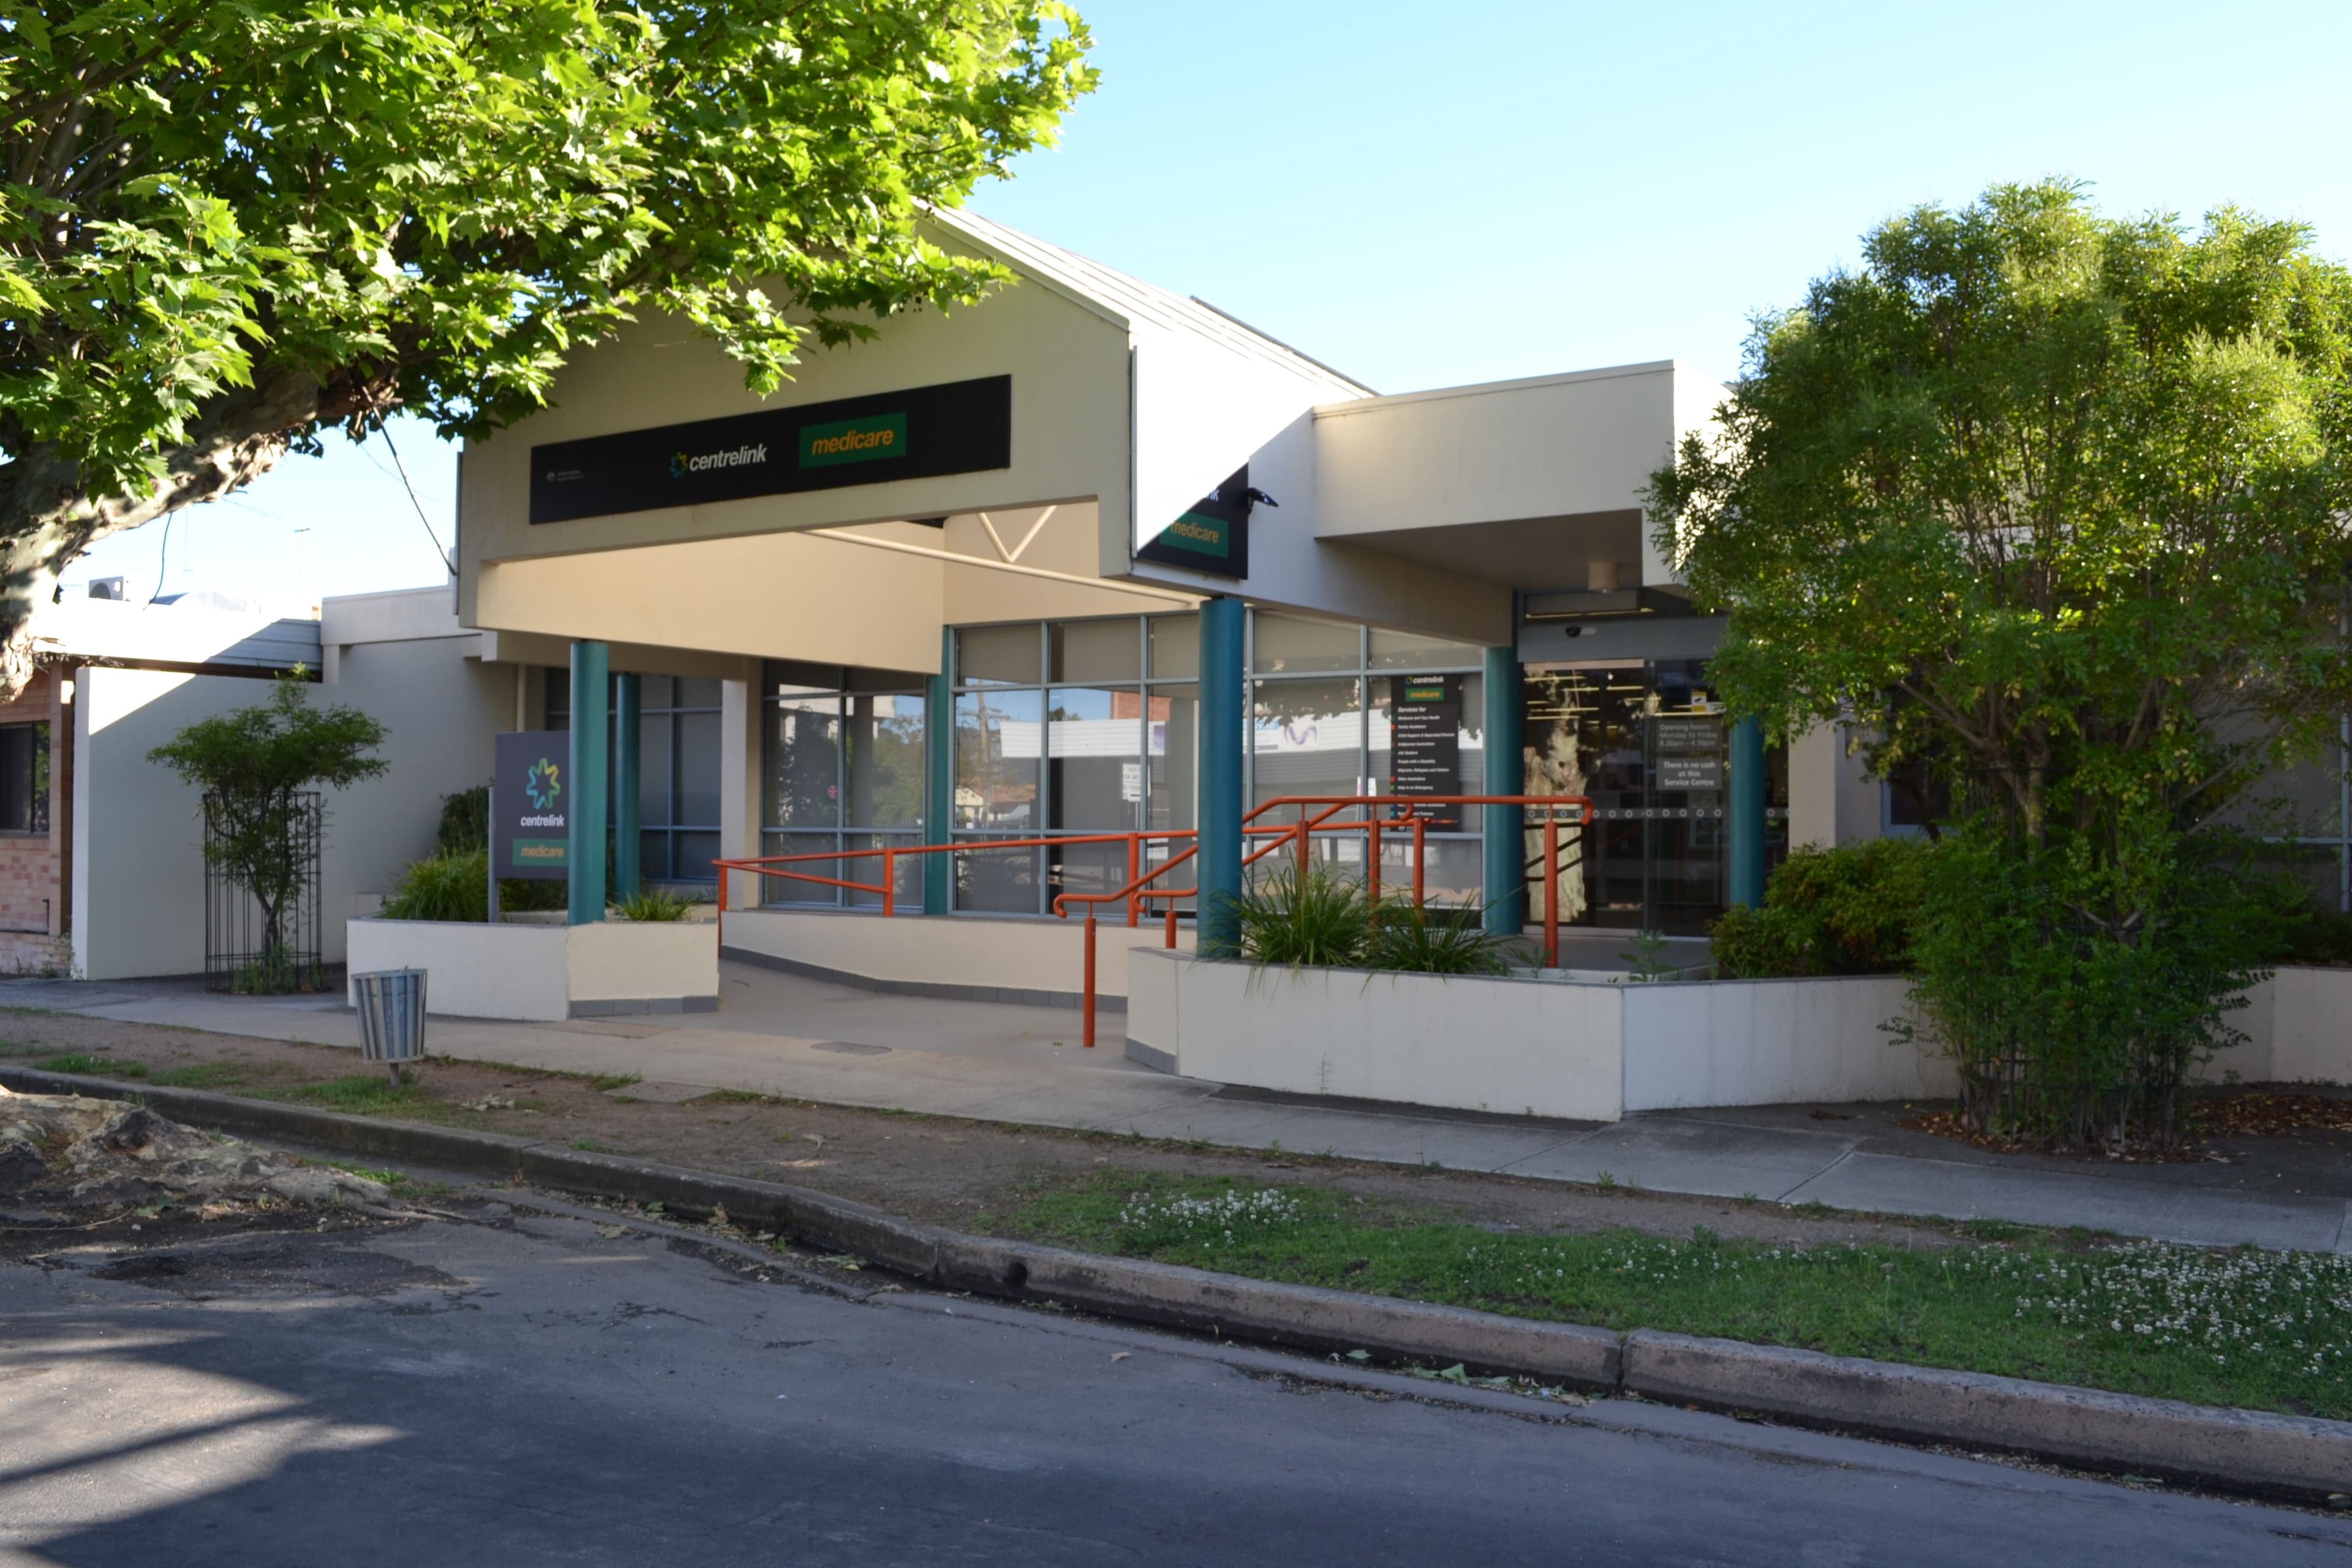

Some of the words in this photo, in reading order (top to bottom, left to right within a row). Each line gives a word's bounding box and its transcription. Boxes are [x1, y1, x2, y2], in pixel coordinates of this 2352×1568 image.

[812, 429, 894, 456] medicare
[689, 442, 767, 472] centrelink
[1170, 520, 1219, 543] medicare
[520, 813, 565, 827] centrelink
[521, 844, 564, 858] medicare
